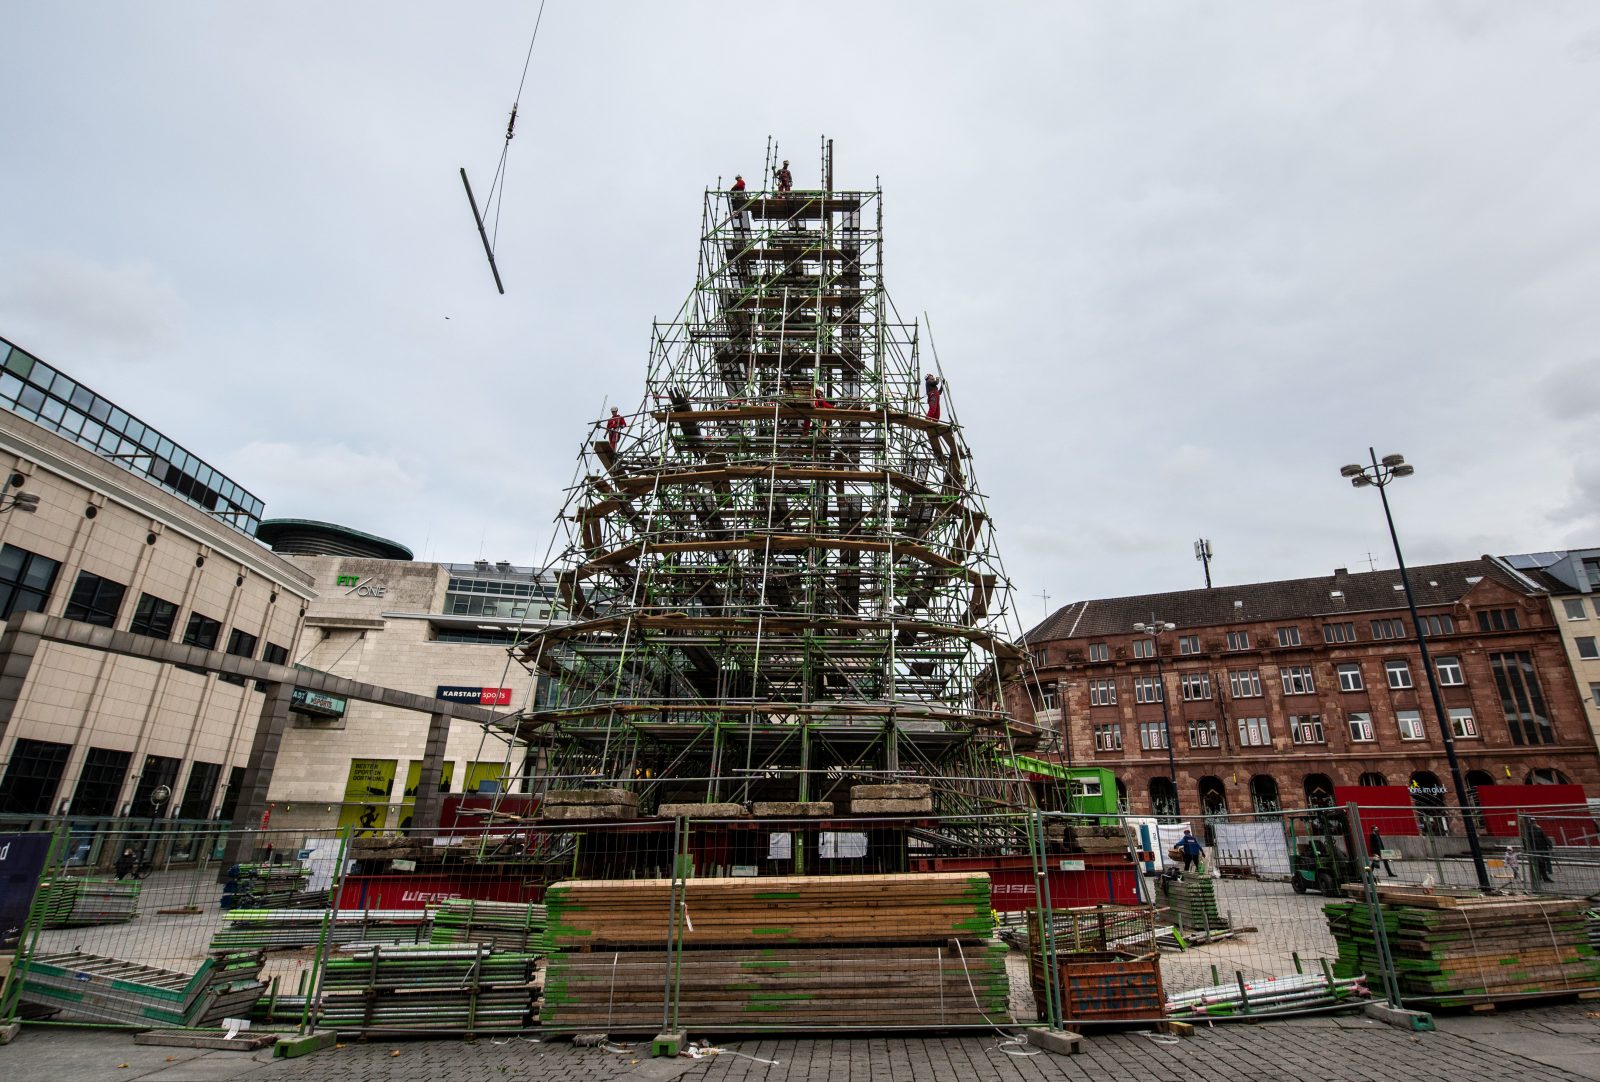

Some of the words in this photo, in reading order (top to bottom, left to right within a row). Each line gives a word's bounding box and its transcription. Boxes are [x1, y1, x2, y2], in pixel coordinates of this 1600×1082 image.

[337, 575, 359, 587] FIT
[357, 585, 386, 598] ONE
[442, 690, 481, 698] KARSTADT
[989, 884, 1037, 895] EISE
